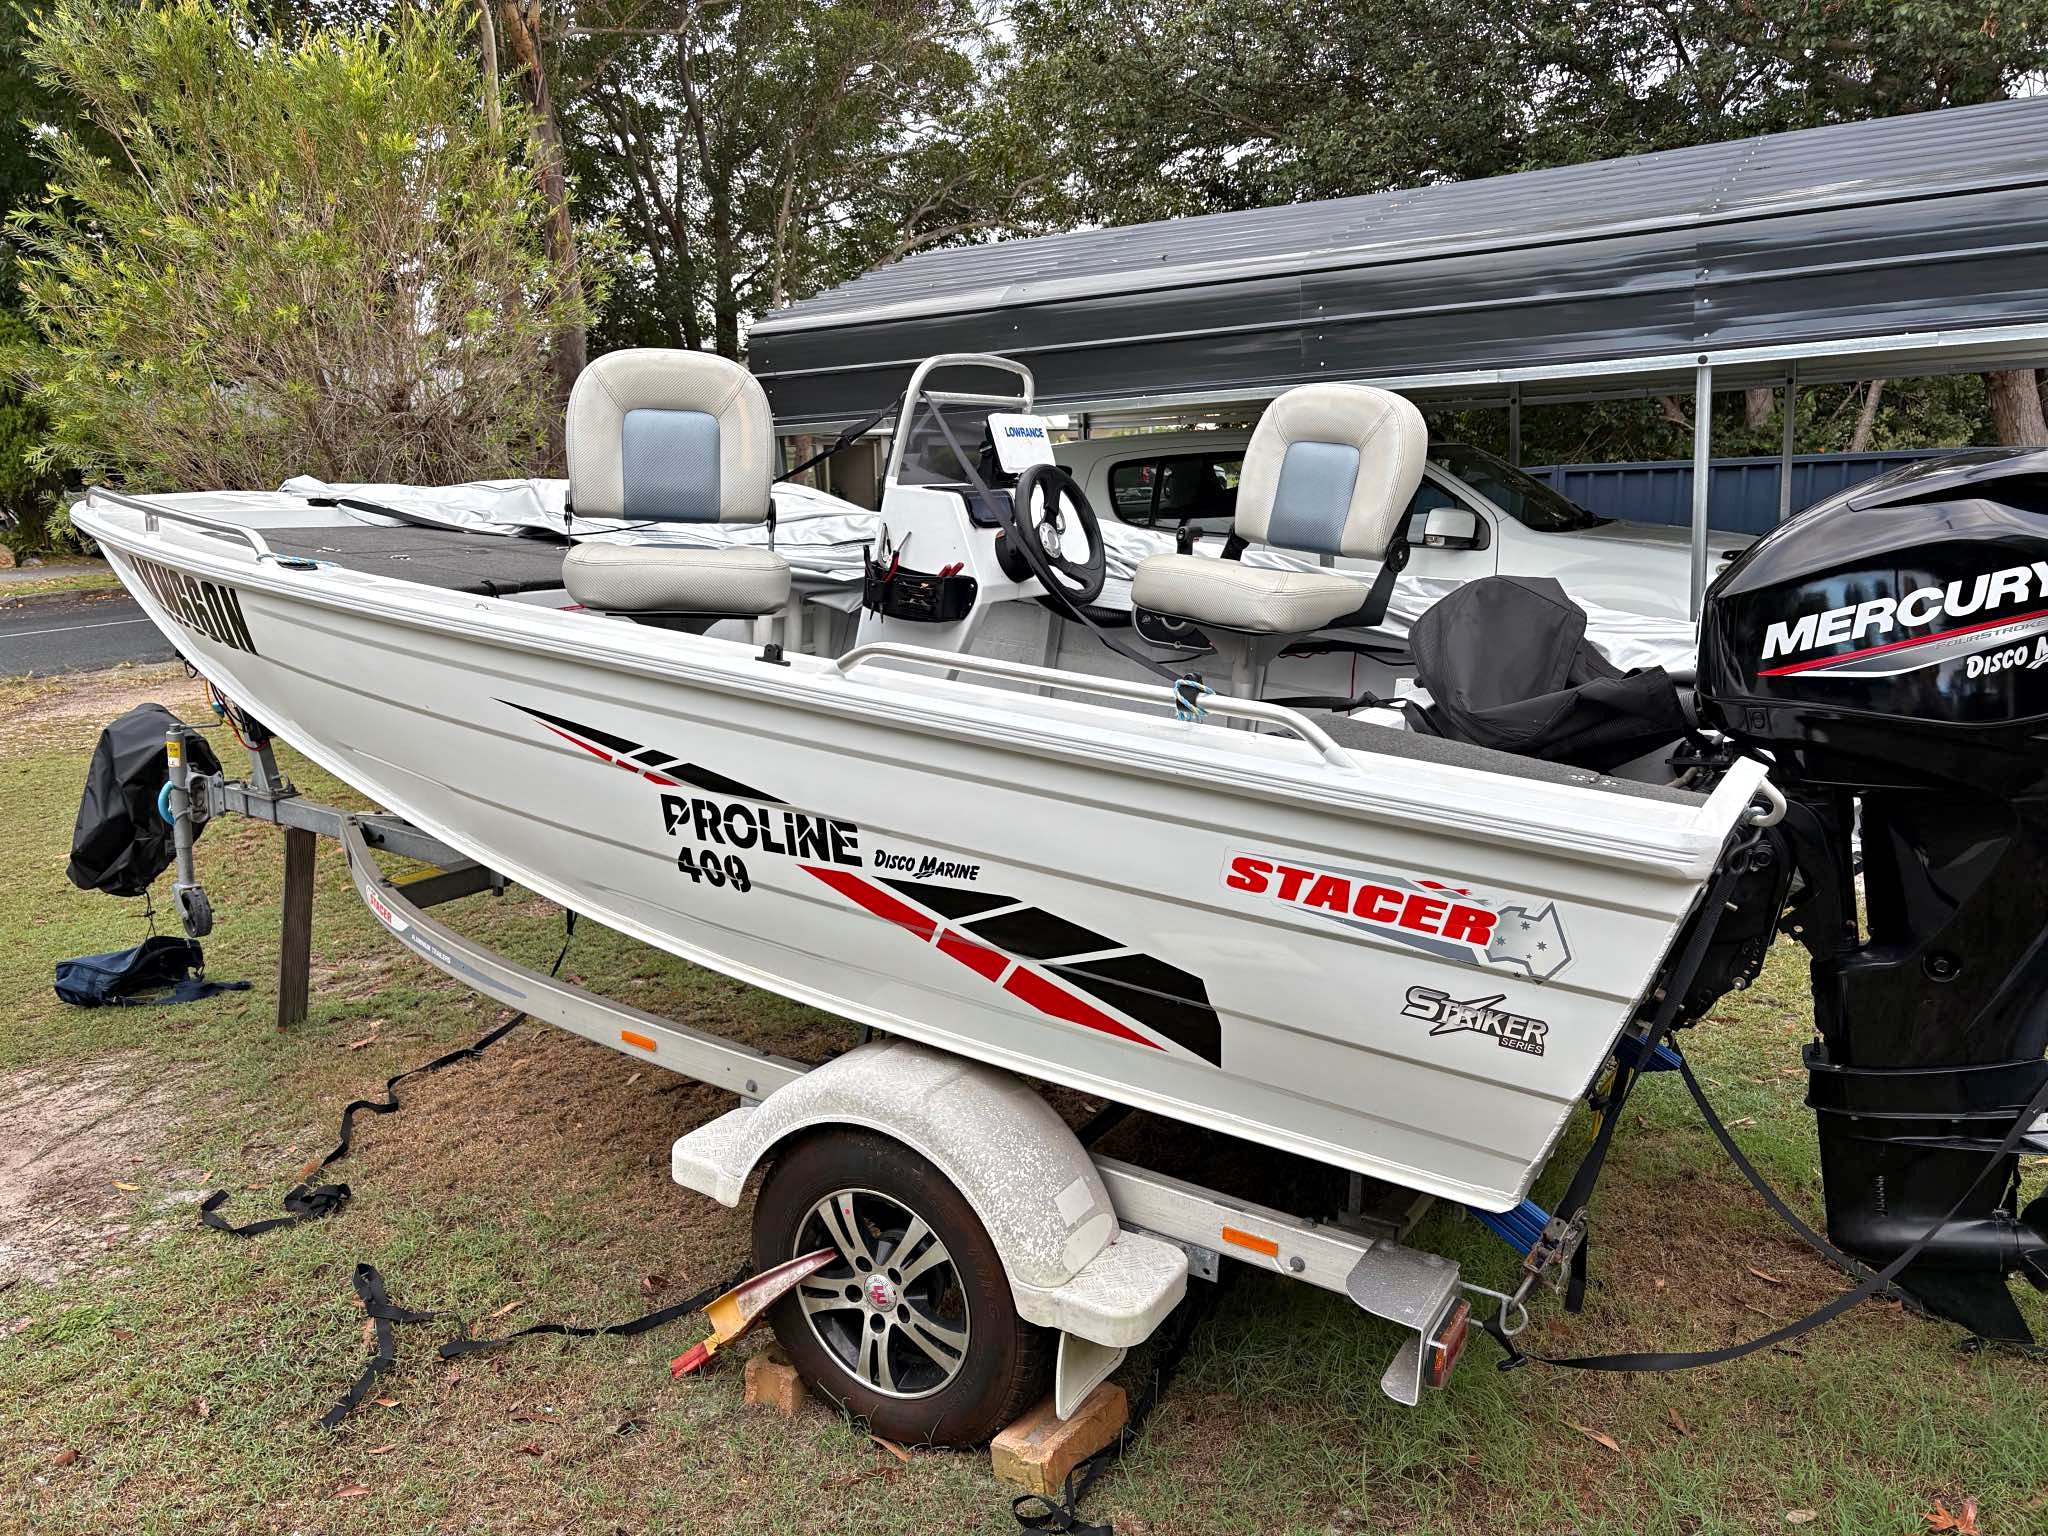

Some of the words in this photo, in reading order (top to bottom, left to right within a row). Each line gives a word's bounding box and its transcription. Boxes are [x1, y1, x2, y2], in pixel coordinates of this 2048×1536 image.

[1005, 426, 1045, 438] LOWRANCE
[1761, 560, 2048, 660] MERCURY
[1935, 619, 2046, 650] FOURSTROKE
[660, 793, 863, 868] PROLINE
[677, 847, 752, 893] 409
[914, 856, 980, 881] MARINE
[369, 895, 392, 923] STACER
[1226, 856, 1498, 946] STACER
[432, 946, 451, 964] TRAILERS
[1400, 985, 1549, 1047] STRIKER
[1500, 1037, 1543, 1055] SERIES
